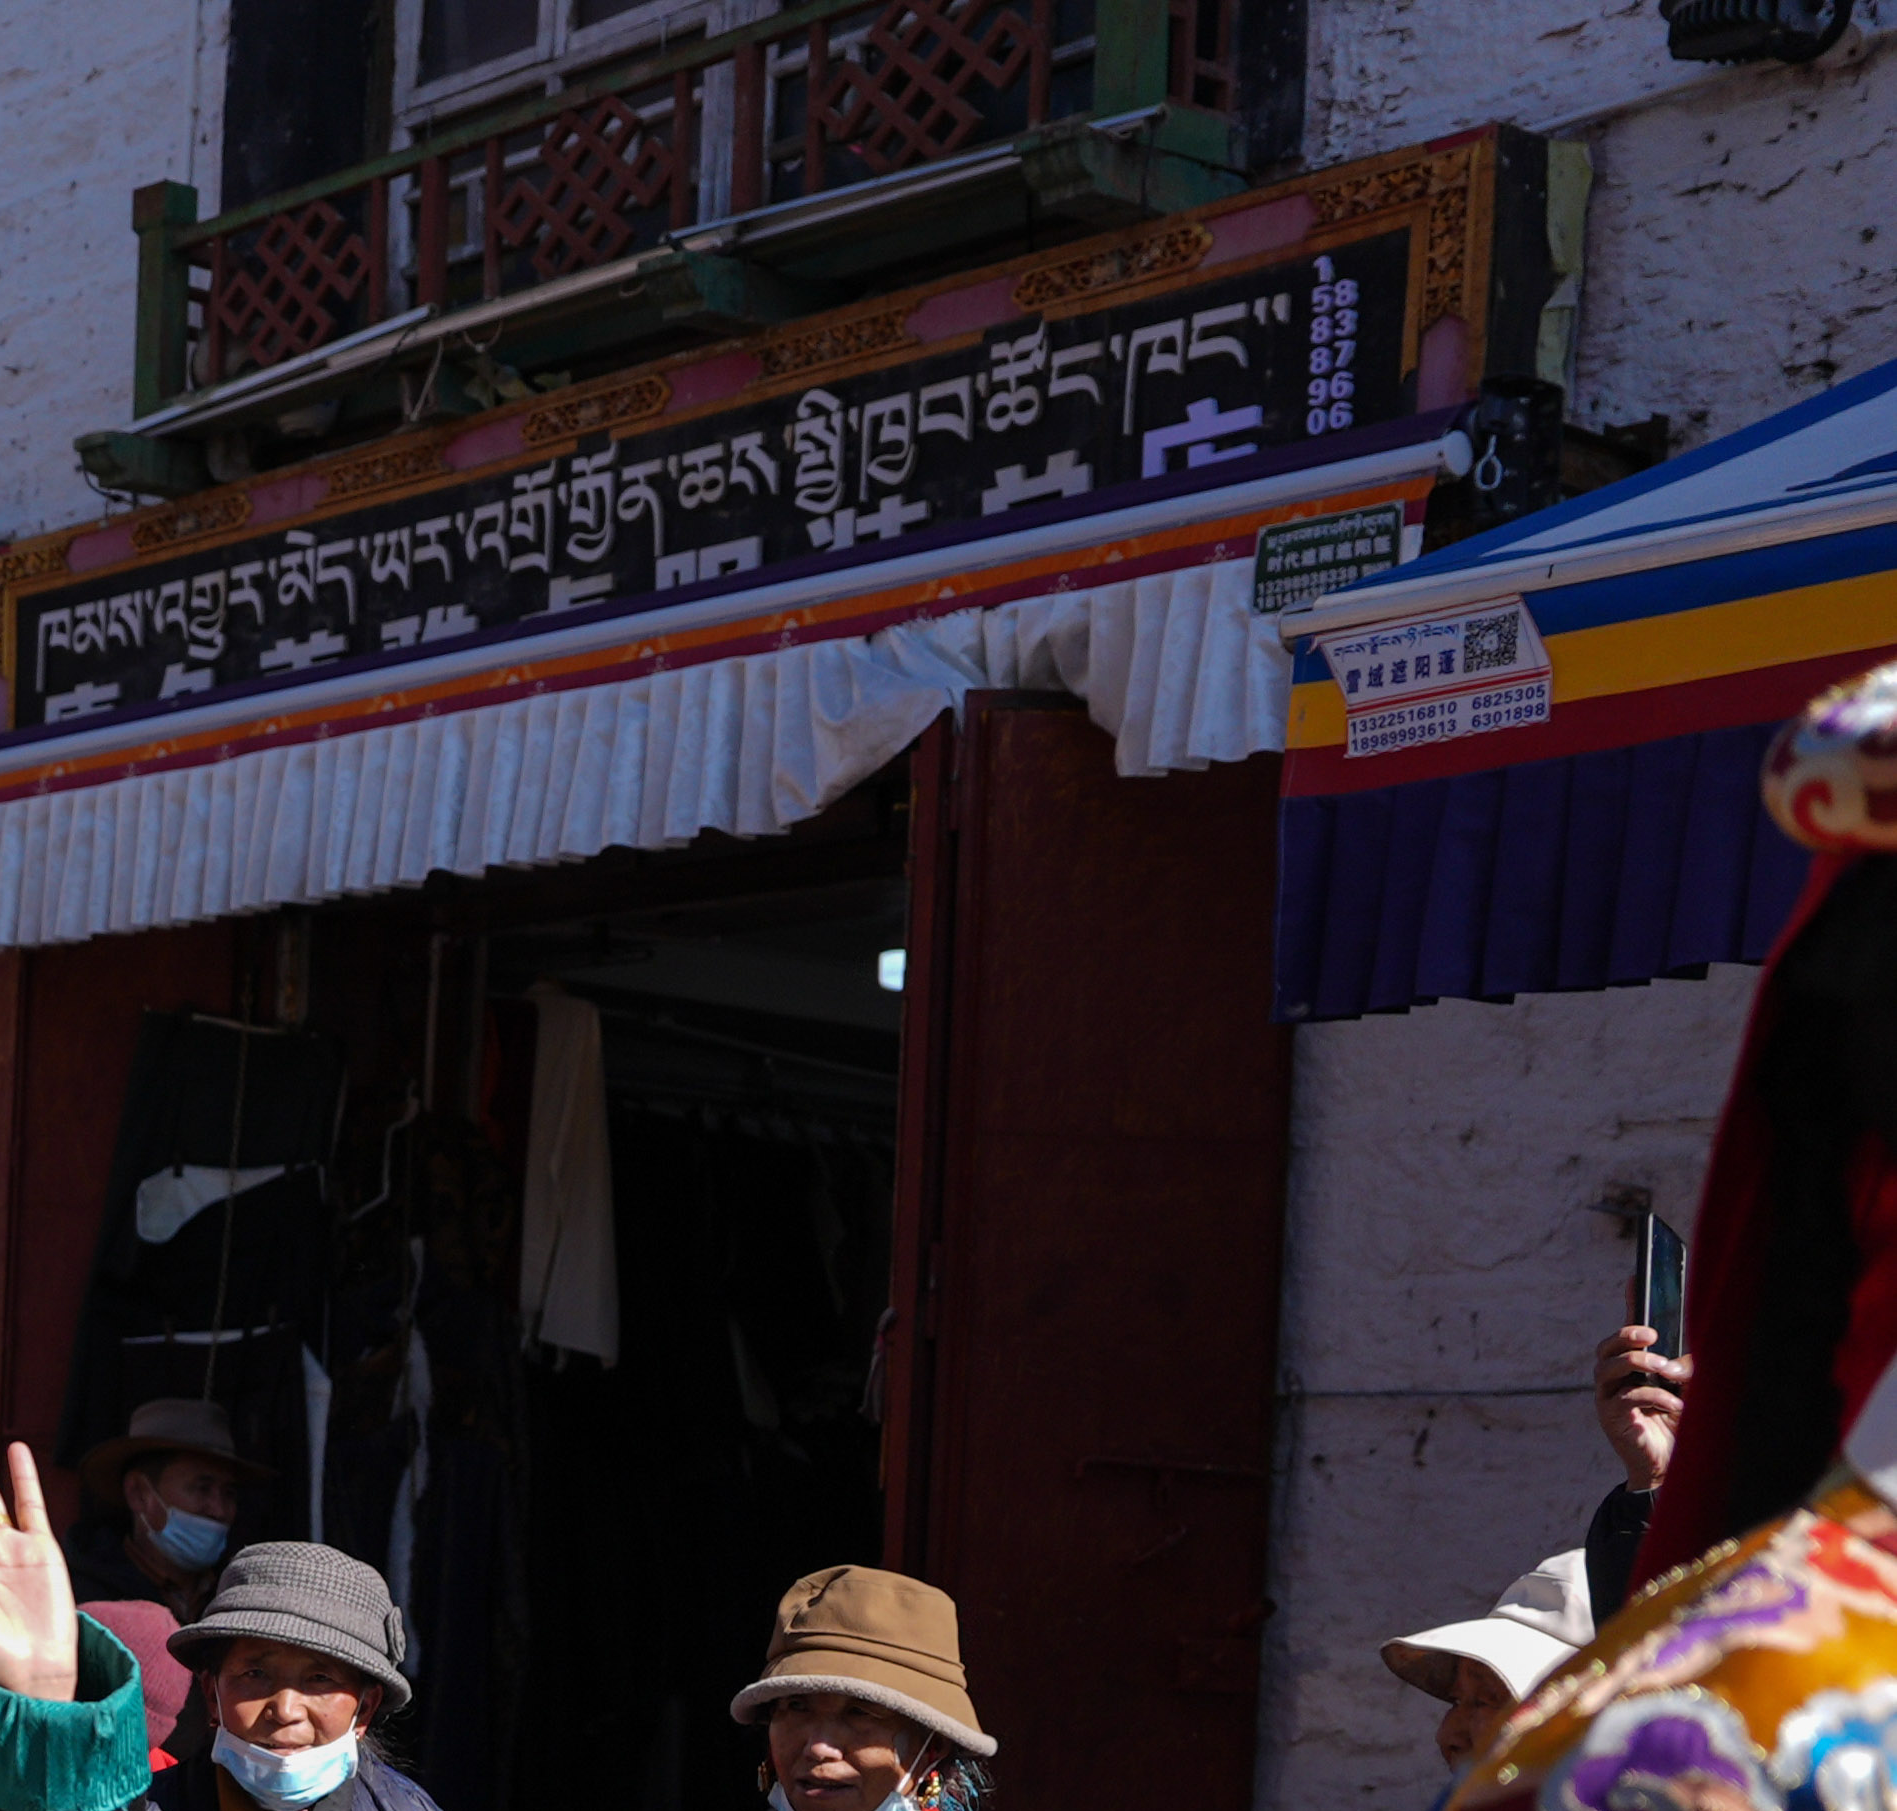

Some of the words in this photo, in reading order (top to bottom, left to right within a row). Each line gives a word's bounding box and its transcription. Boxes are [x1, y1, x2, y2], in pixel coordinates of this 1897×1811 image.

[1350, 700, 1458, 735] 13322516810
[1472, 684, 1546, 710] 6825305
[1351, 719, 1458, 753] 18989993613
[1471, 702, 1546, 730] 6301898
